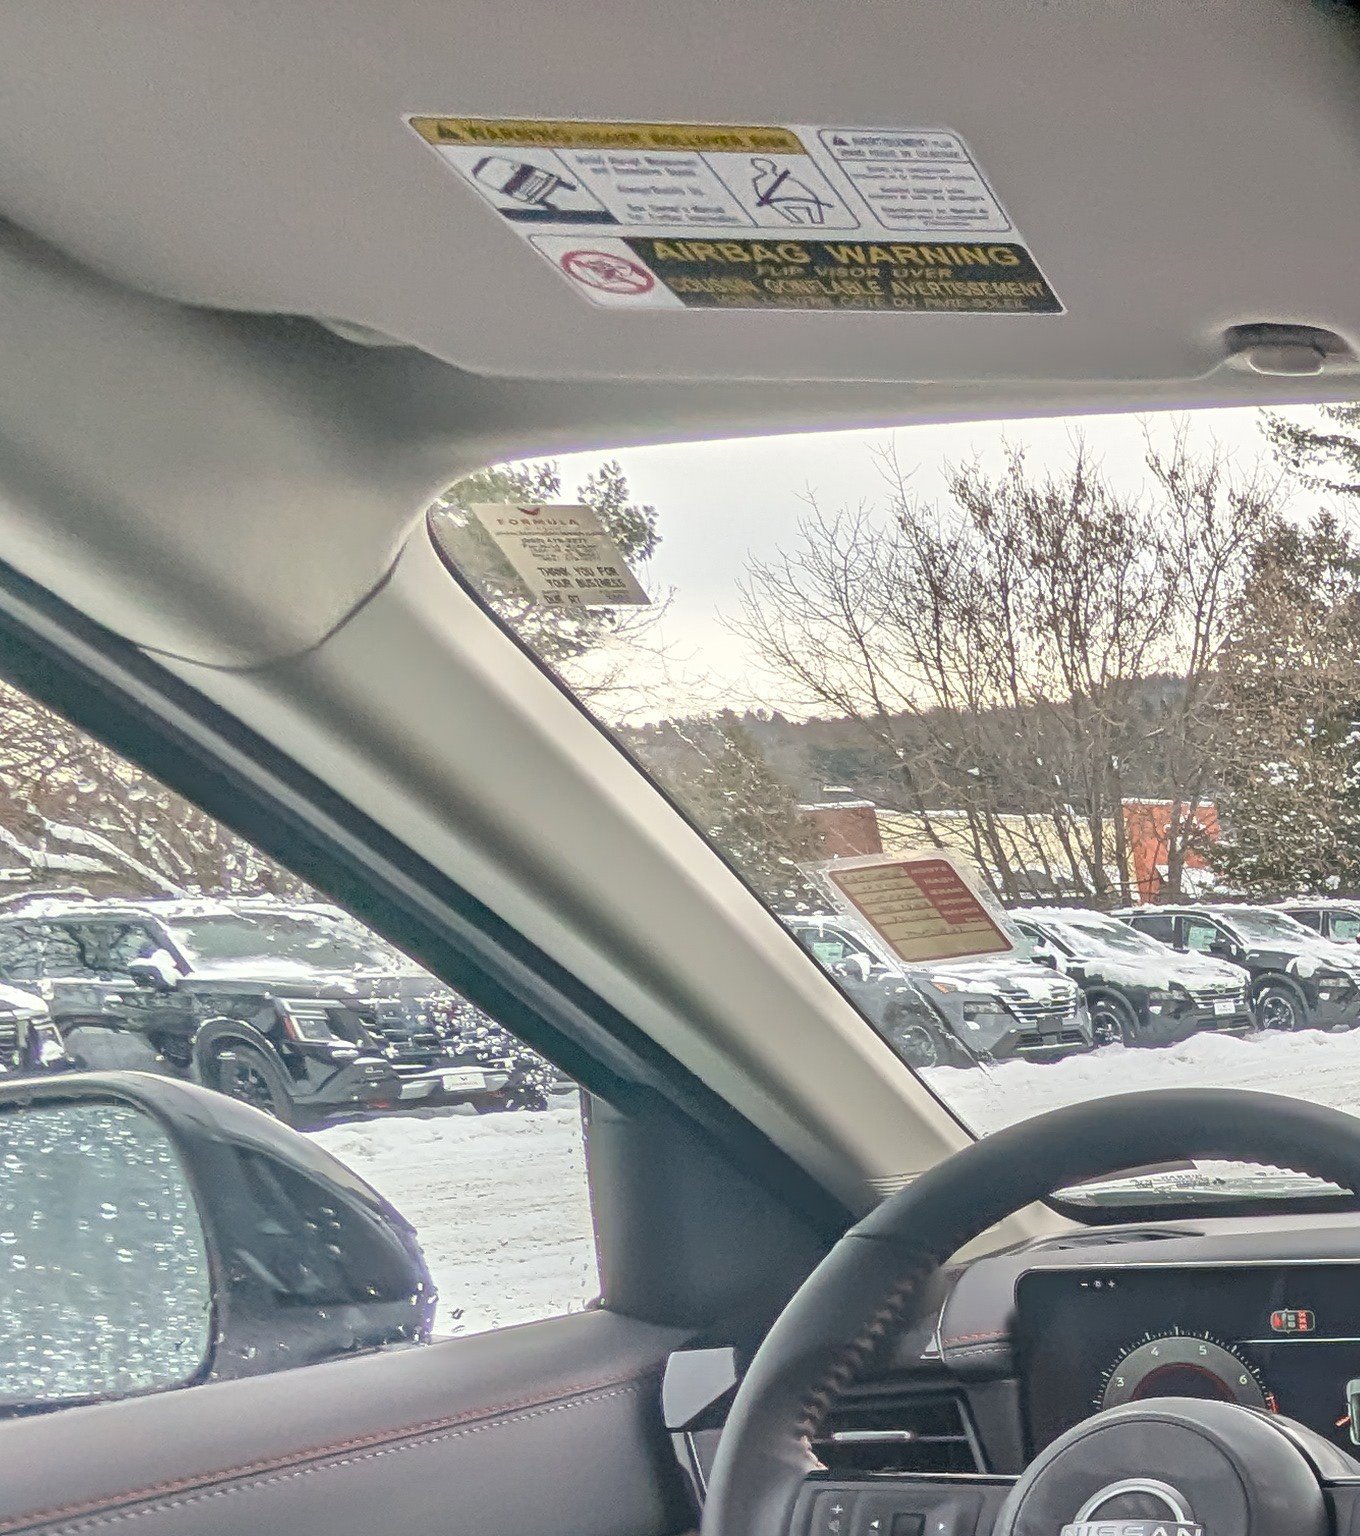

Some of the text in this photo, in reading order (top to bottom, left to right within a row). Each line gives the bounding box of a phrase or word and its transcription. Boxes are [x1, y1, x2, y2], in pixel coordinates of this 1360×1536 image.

[653, 241, 1021, 266] AIRBAG WARNING
[813, 265, 881, 278] VISOR
[892, 267, 952, 281] OVER
[573, 566, 594, 577] YOU
[597, 566, 619, 577] FOR
[547, 578, 626, 589] YOUR BUSINESS
[1151, 1346, 1159, 1356] 4
[1200, 1345, 1207, 1355] 5
[1116, 1377, 1125, 1387] 3
[1239, 1375, 1248, 1385] 6
